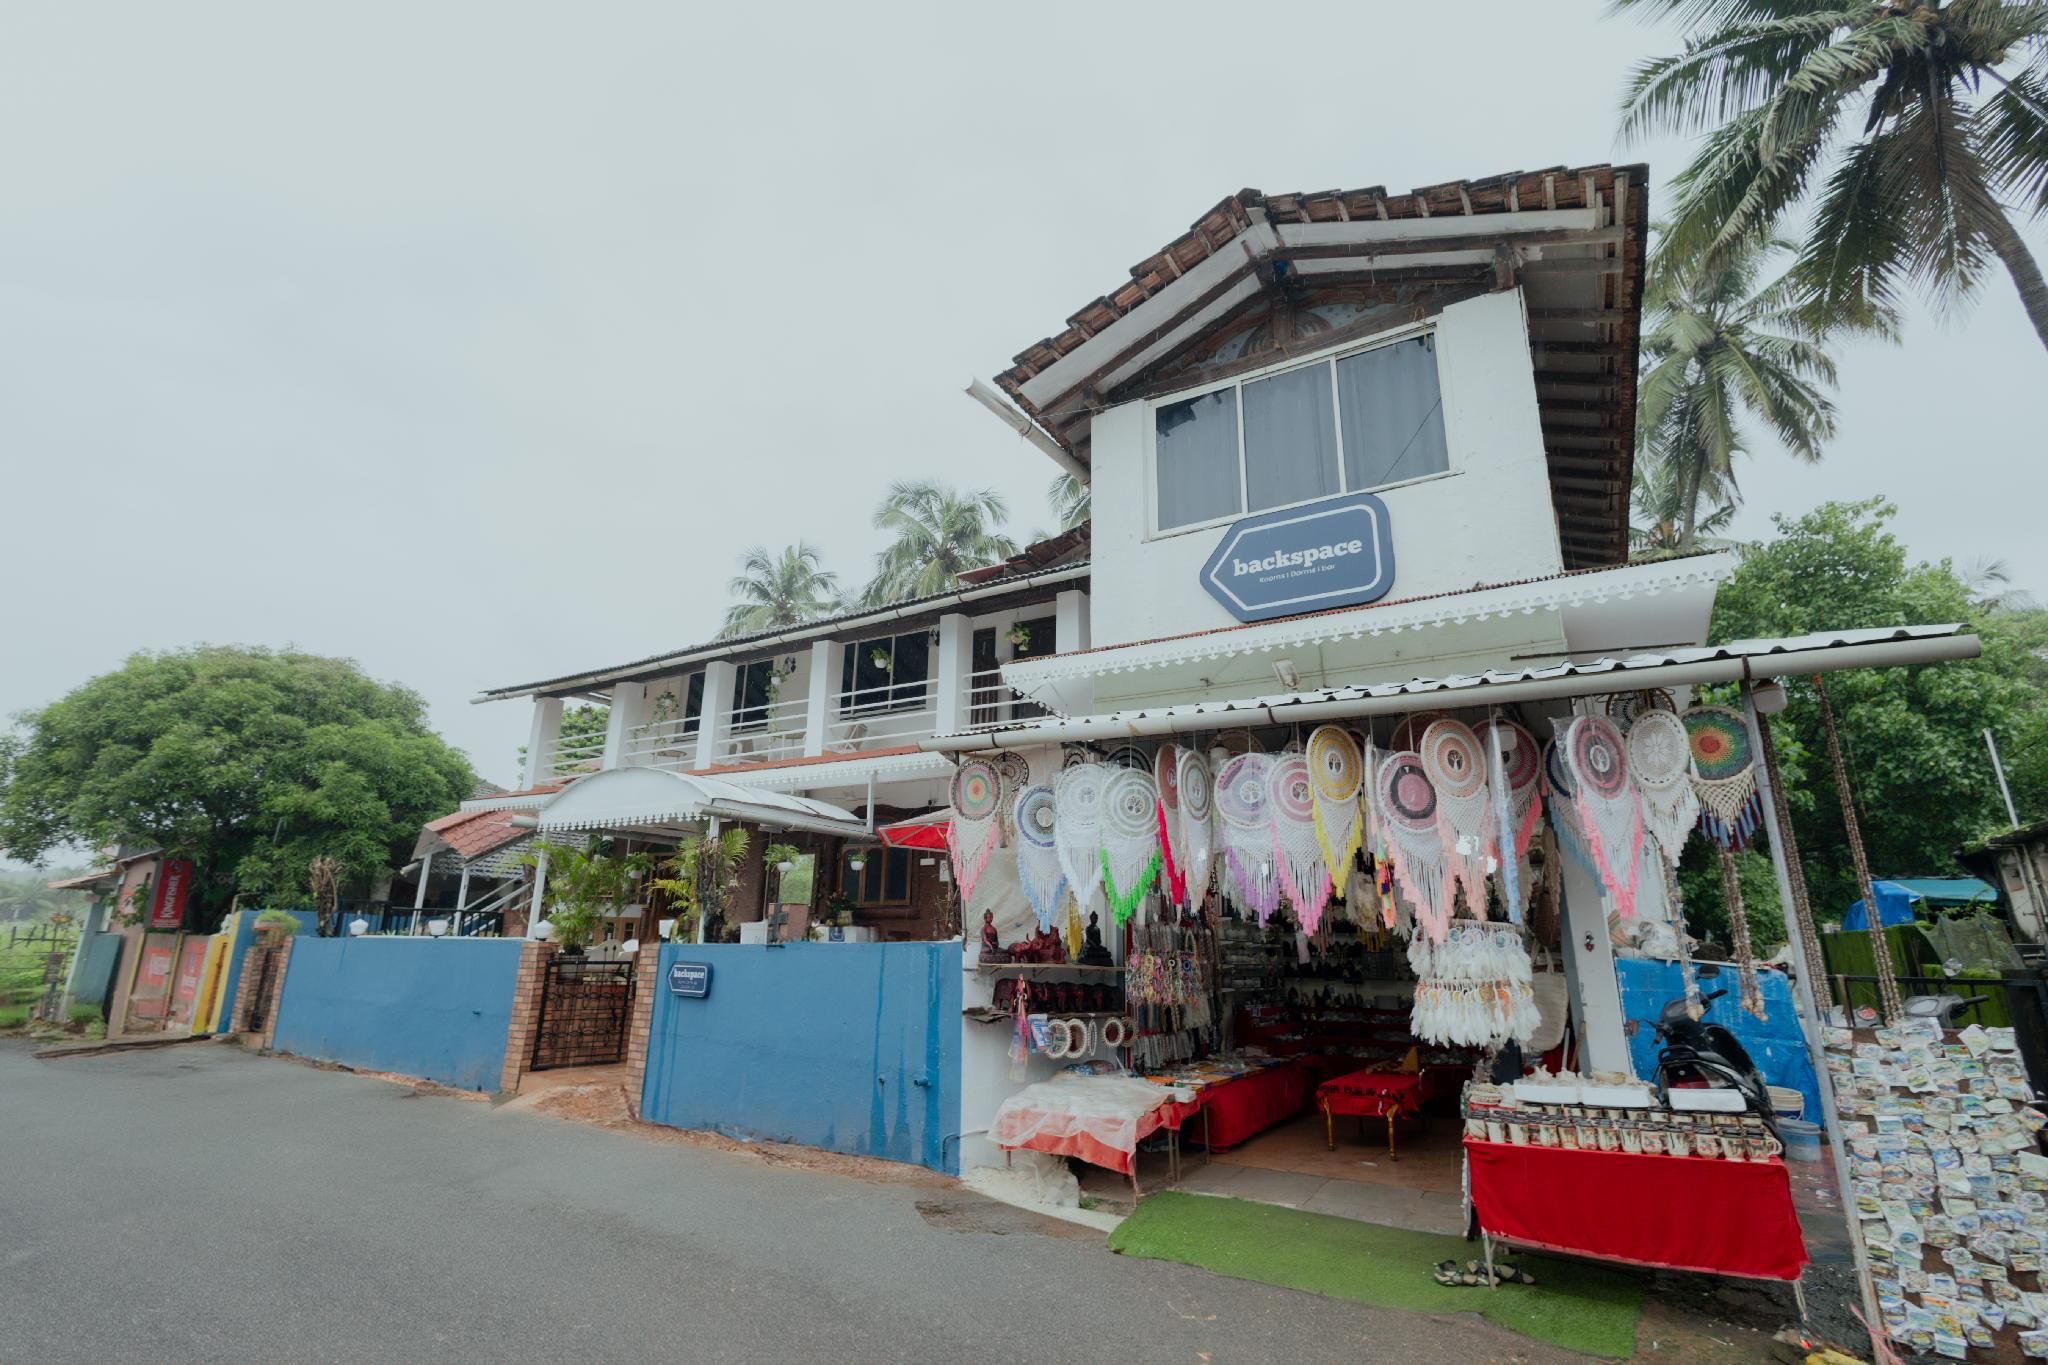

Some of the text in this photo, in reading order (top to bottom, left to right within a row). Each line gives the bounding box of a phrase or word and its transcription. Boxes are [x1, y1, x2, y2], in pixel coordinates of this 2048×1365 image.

[1233, 539, 1363, 576] backspace
[1290, 568, 1316, 577] Dorms
[674, 969, 704, 981] backspace
